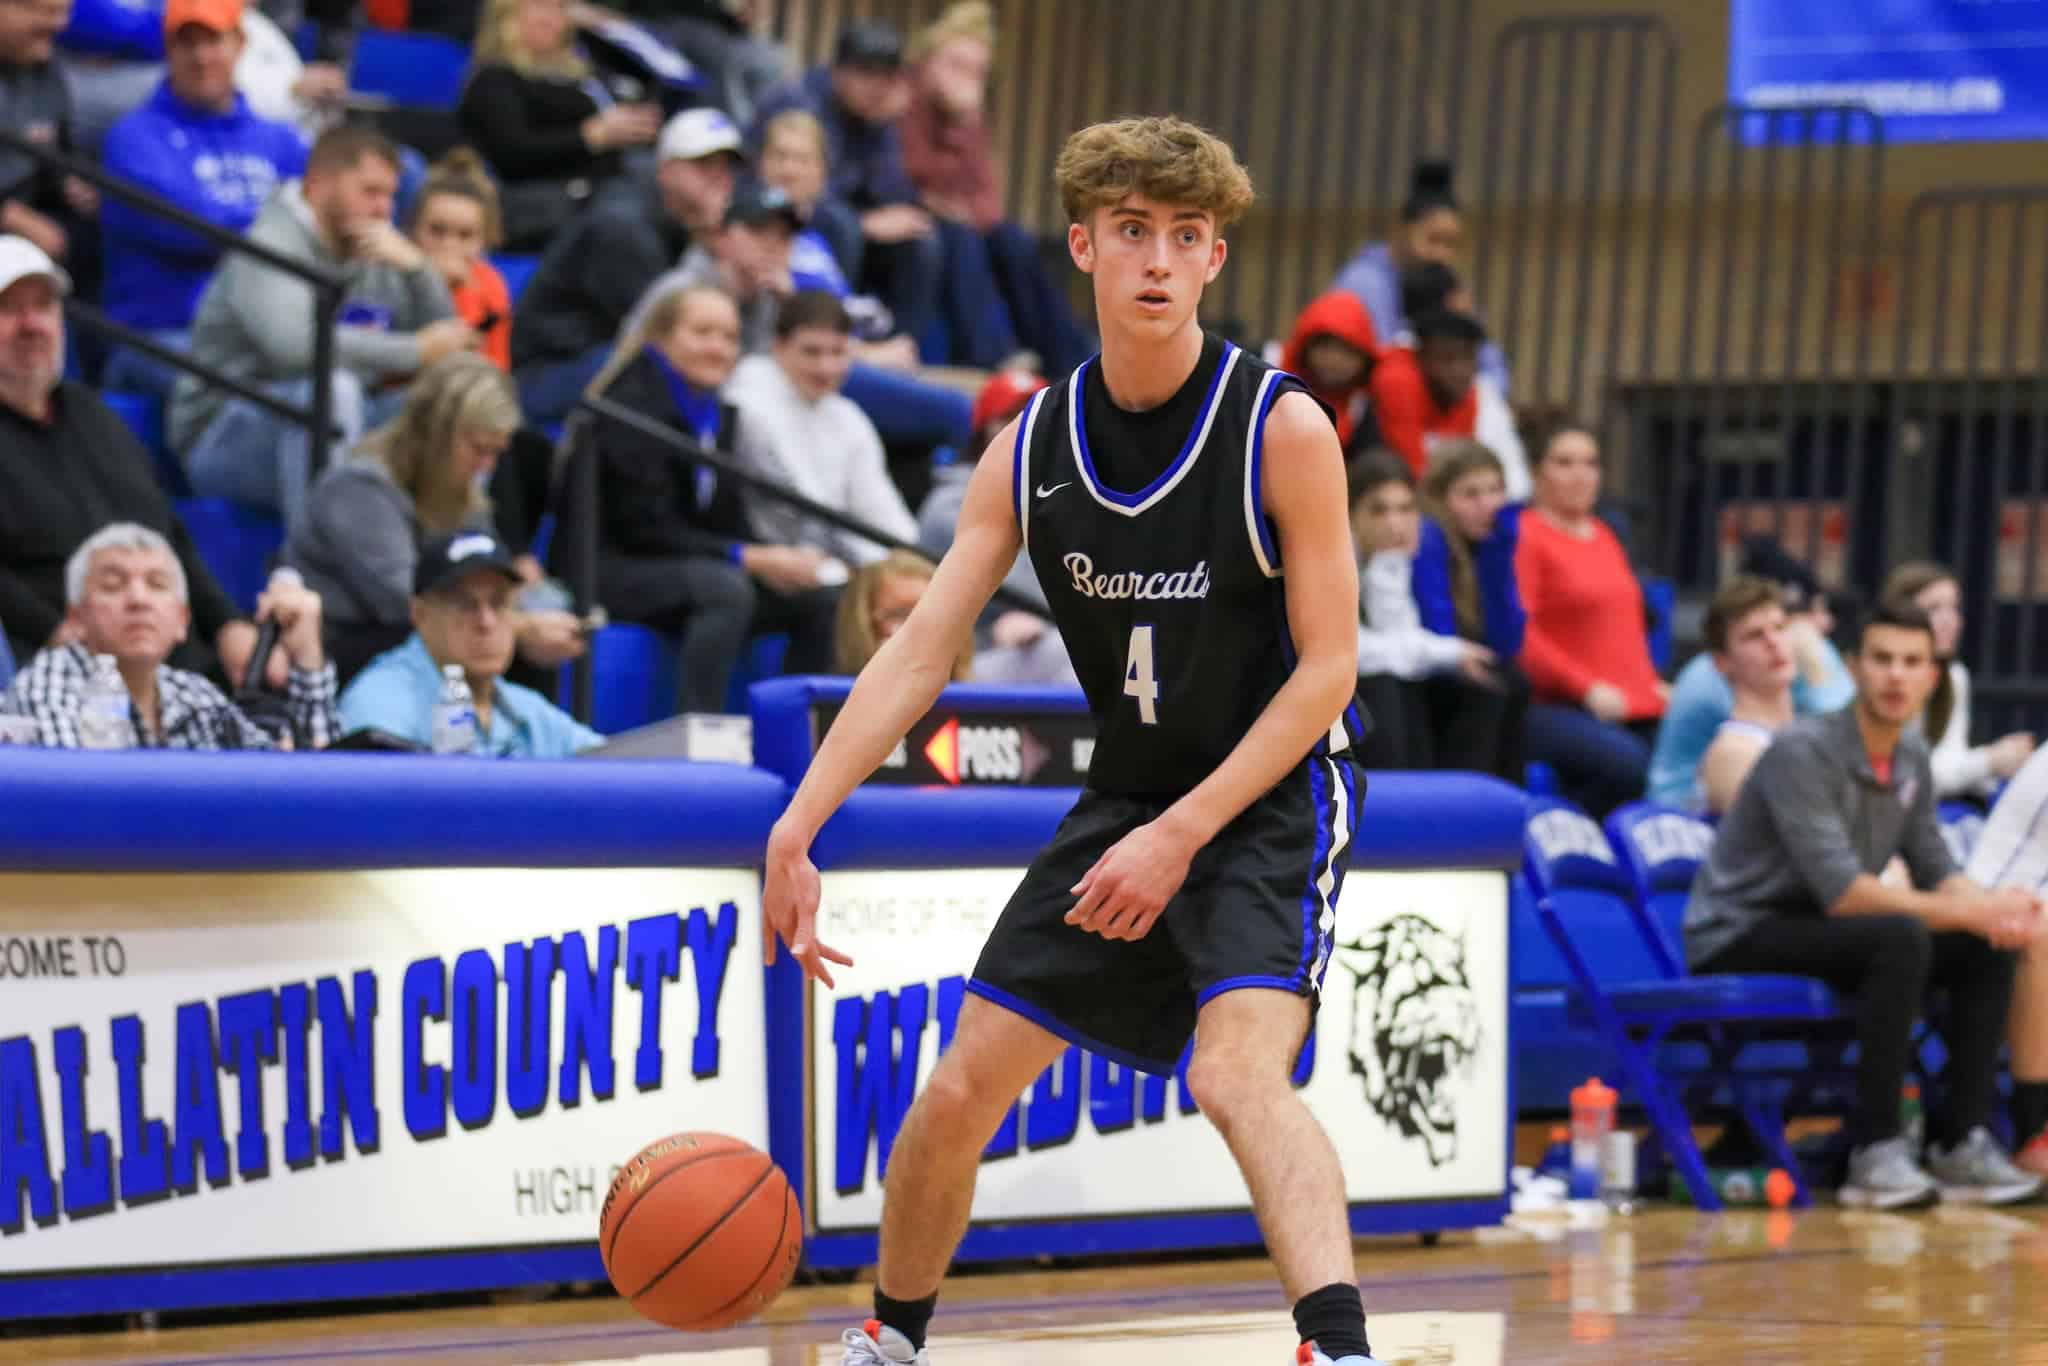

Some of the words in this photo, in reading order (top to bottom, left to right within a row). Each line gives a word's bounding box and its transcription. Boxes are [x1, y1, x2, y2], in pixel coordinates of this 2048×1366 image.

[1124, 624, 1160, 724] 4
[957, 726, 1022, 780] POSS
[824, 896, 896, 935] HOME
[903, 896, 936, 934] OF
[944, 896, 988, 934] THE
[82, 937, 126, 977] TO
[0, 968, 380, 1237] ALLATIN
[402, 900, 738, 1143] COUNTY
[513, 1165, 597, 1215] HIGH
